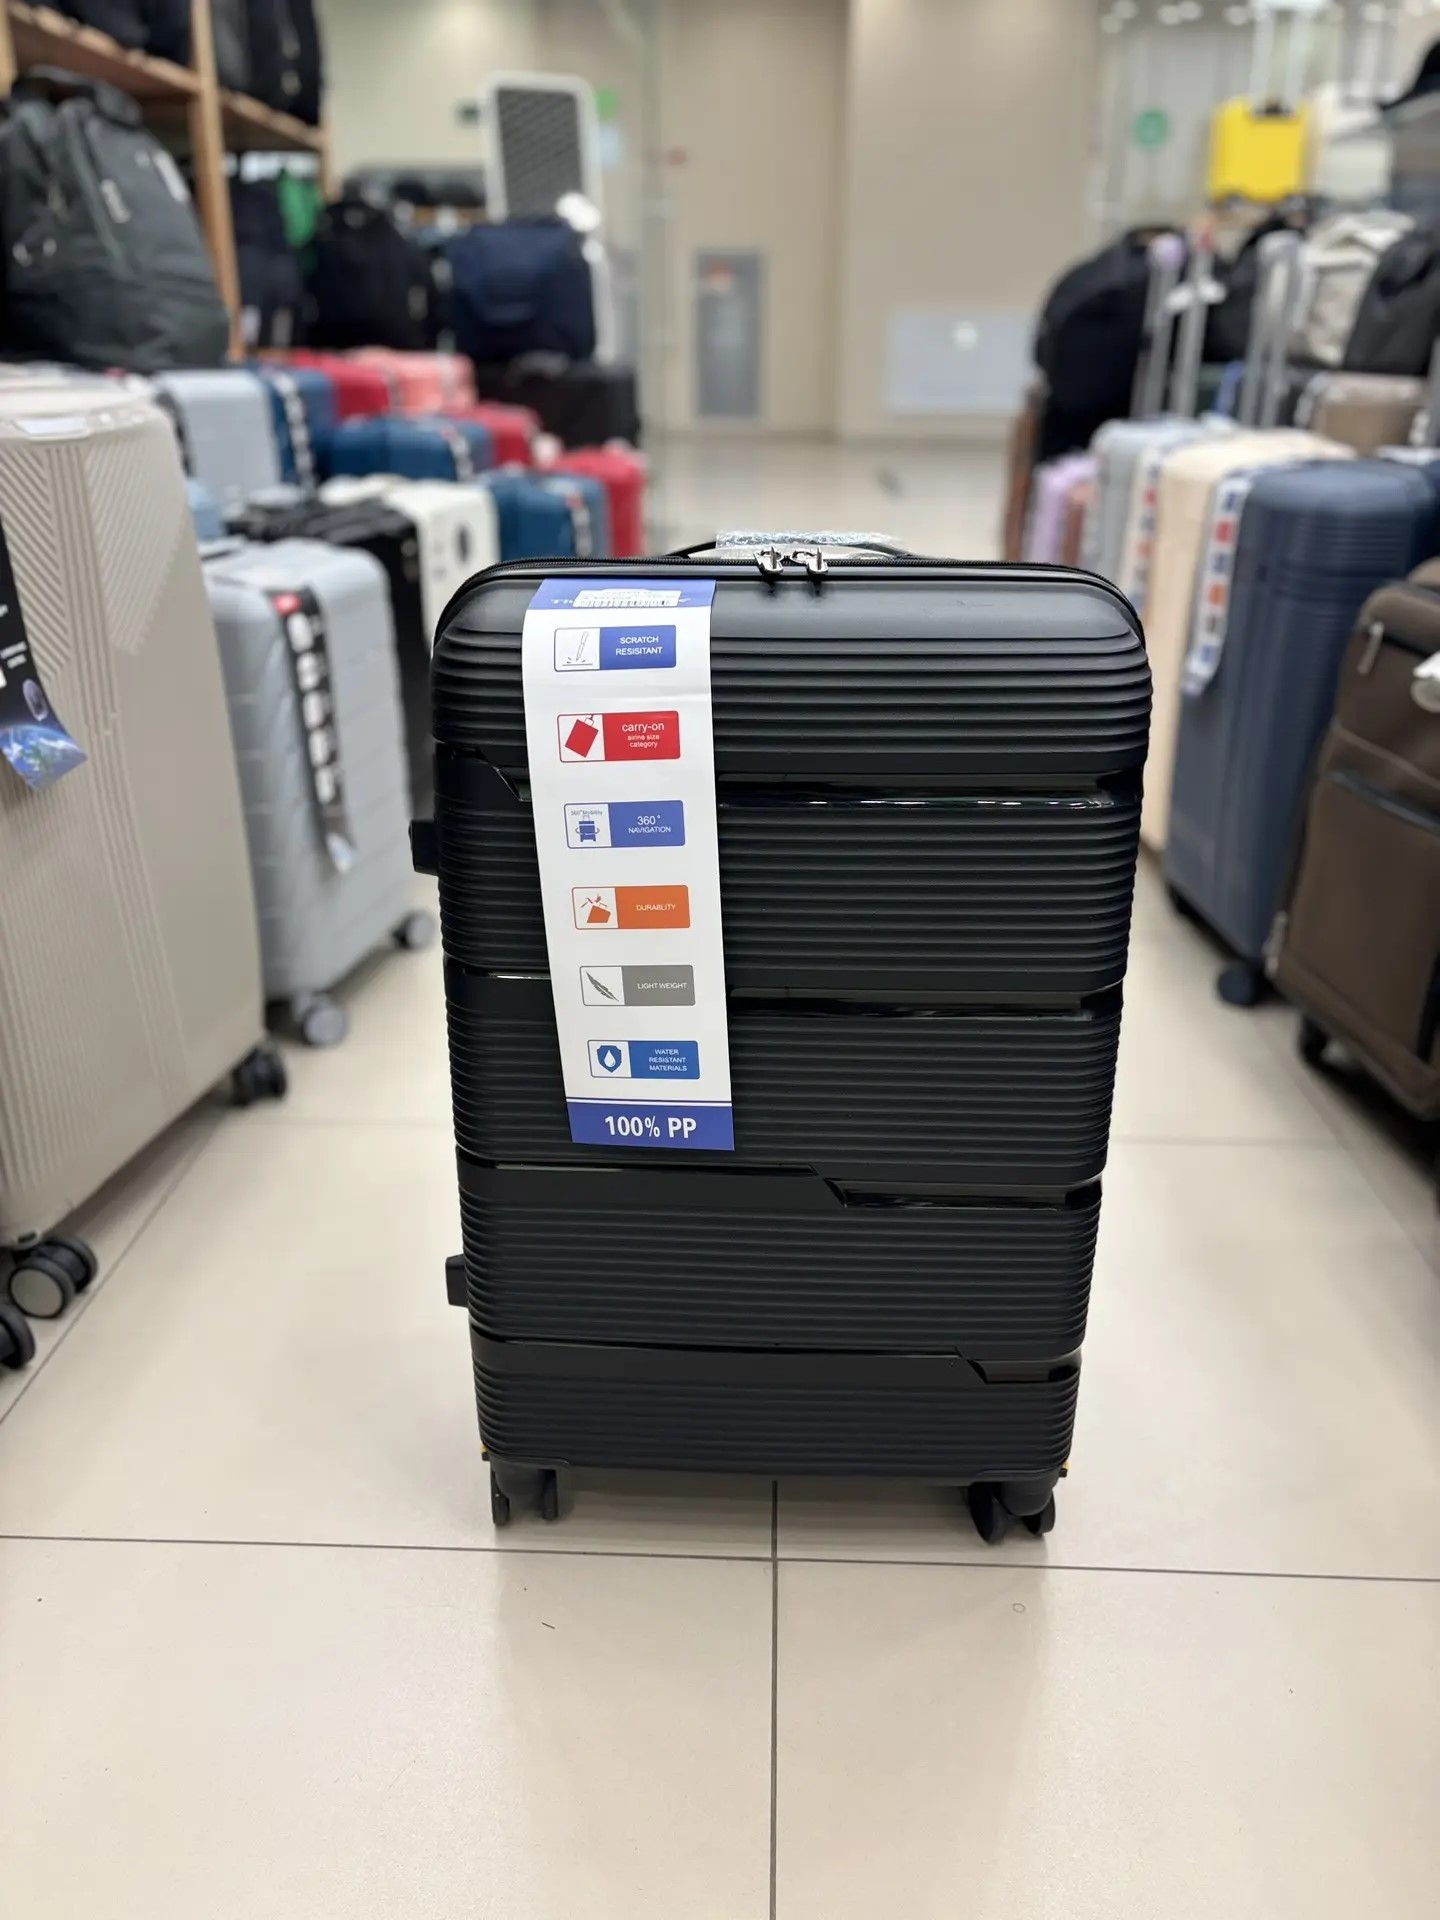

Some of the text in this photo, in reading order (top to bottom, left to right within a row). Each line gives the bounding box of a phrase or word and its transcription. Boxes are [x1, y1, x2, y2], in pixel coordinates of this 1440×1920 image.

[620, 635, 659, 645] SCRATCH
[615, 646, 663, 656] RESISITANT
[622, 722, 665, 734] carry-on
[630, 740, 658, 748] category
[628, 826, 672, 834] NAVIGATION
[604, 1115, 697, 1139] 100% PP
